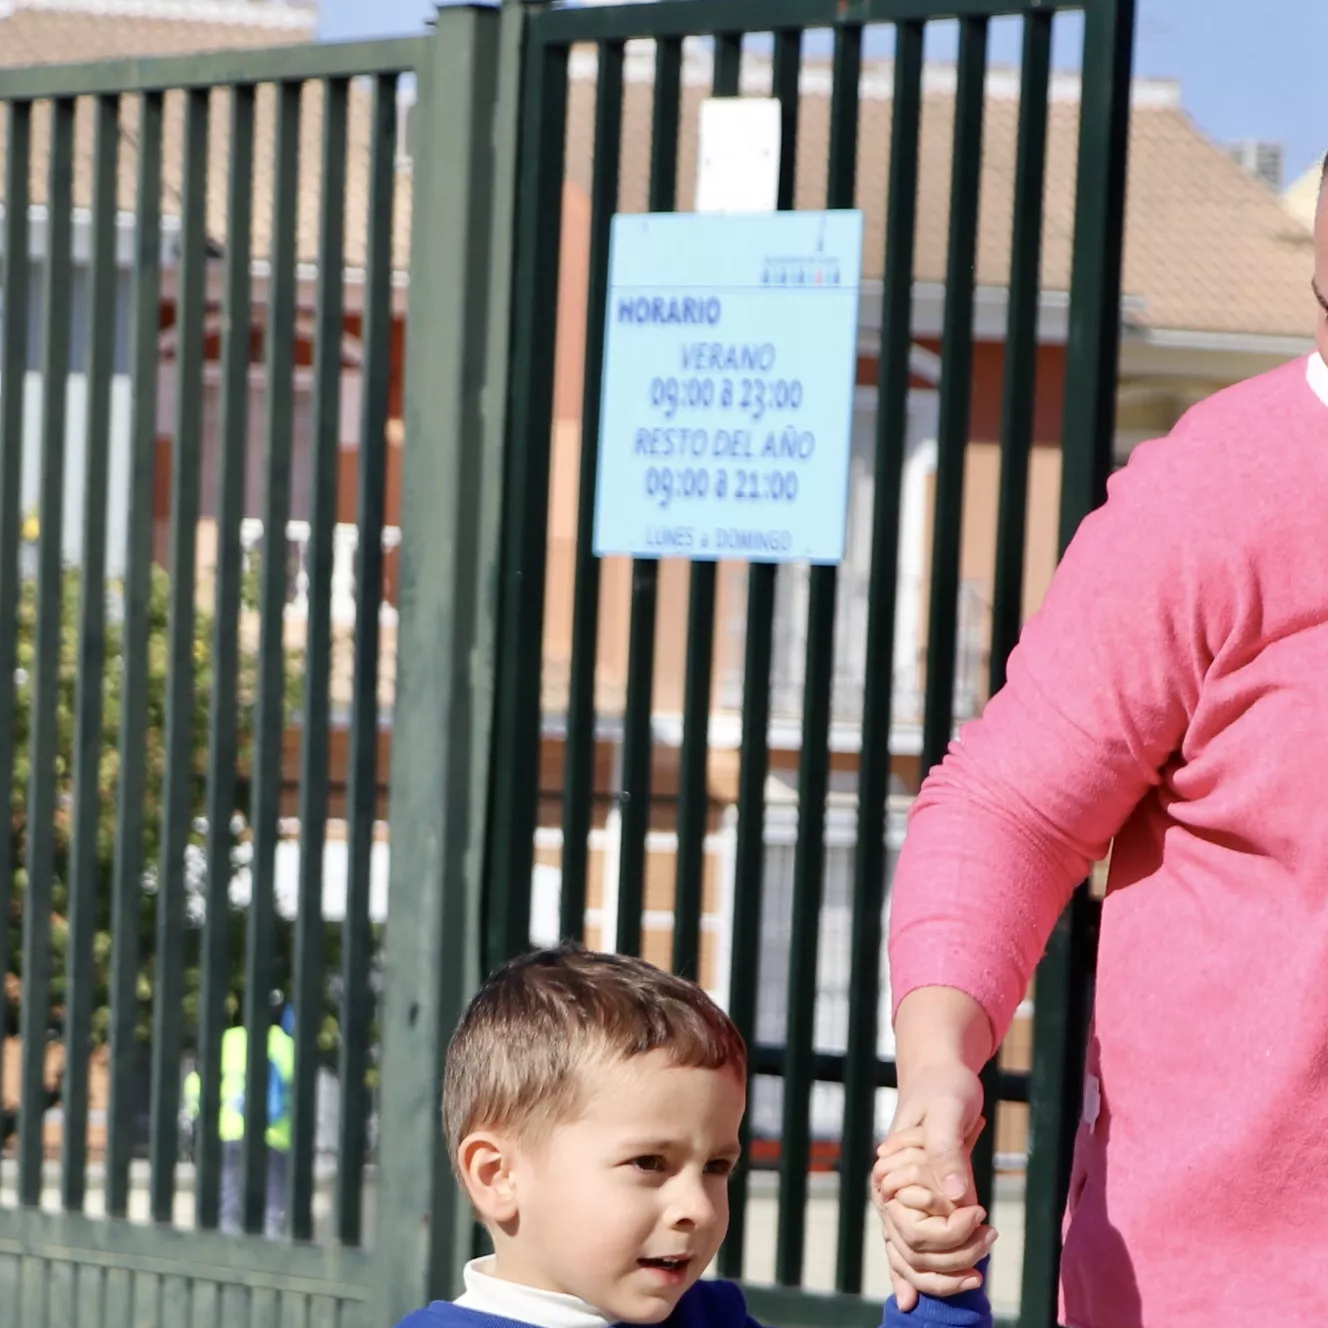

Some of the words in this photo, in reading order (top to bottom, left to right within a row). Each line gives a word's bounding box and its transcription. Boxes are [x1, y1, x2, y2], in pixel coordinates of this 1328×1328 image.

[618, 296, 722, 325] HORARIO
[681, 341, 776, 372] VERANO
[651, 375, 715, 418] 09:00
[739, 377, 804, 420] 23:00
[634, 426, 708, 457] RESTO
[712, 428, 755, 457] DEL
[760, 424, 816, 459] AÑO
[645, 465, 710, 508] 09:00
[734, 467, 800, 501] 21:00
[645, 525, 694, 548] LUNES
[715, 527, 792, 551] DOMINGO
